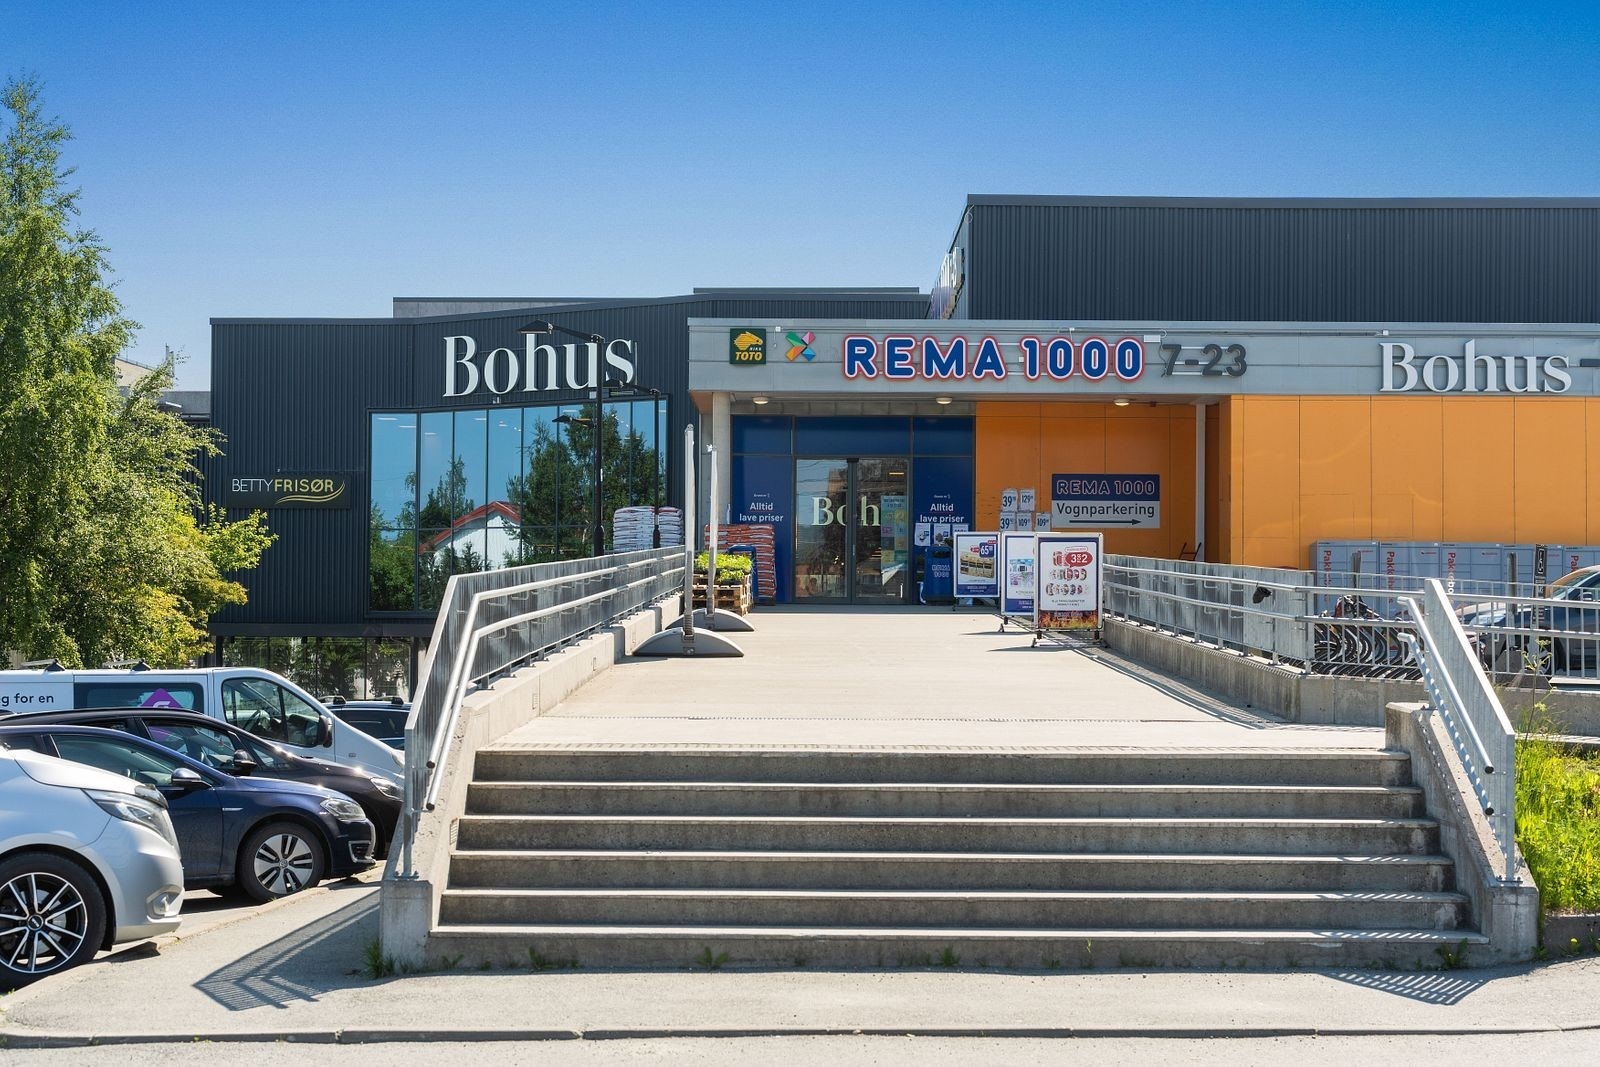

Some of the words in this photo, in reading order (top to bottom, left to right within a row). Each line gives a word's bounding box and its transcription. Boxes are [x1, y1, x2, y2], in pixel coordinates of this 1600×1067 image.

[735, 352, 762, 360] TOTO
[842, 335, 1006, 381] REMA
[1020, 337, 1144, 382] 1000
[1160, 344, 1248, 377] 7-23
[443, 335, 634, 397] Bohus
[1379, 338, 1572, 393] Bohus
[1056, 480, 1110, 495] REMA
[1115, 480, 1155, 495] 1000
[750, 503, 773, 511] Alltid
[1056, 502, 1155, 517] Vognparkering
[739, 514, 757, 522] lave
[759, 514, 784, 523] priser
[940, 515, 964, 523] priser
[14, 693, 34, 703] for
[38, 695, 54, 704] en
